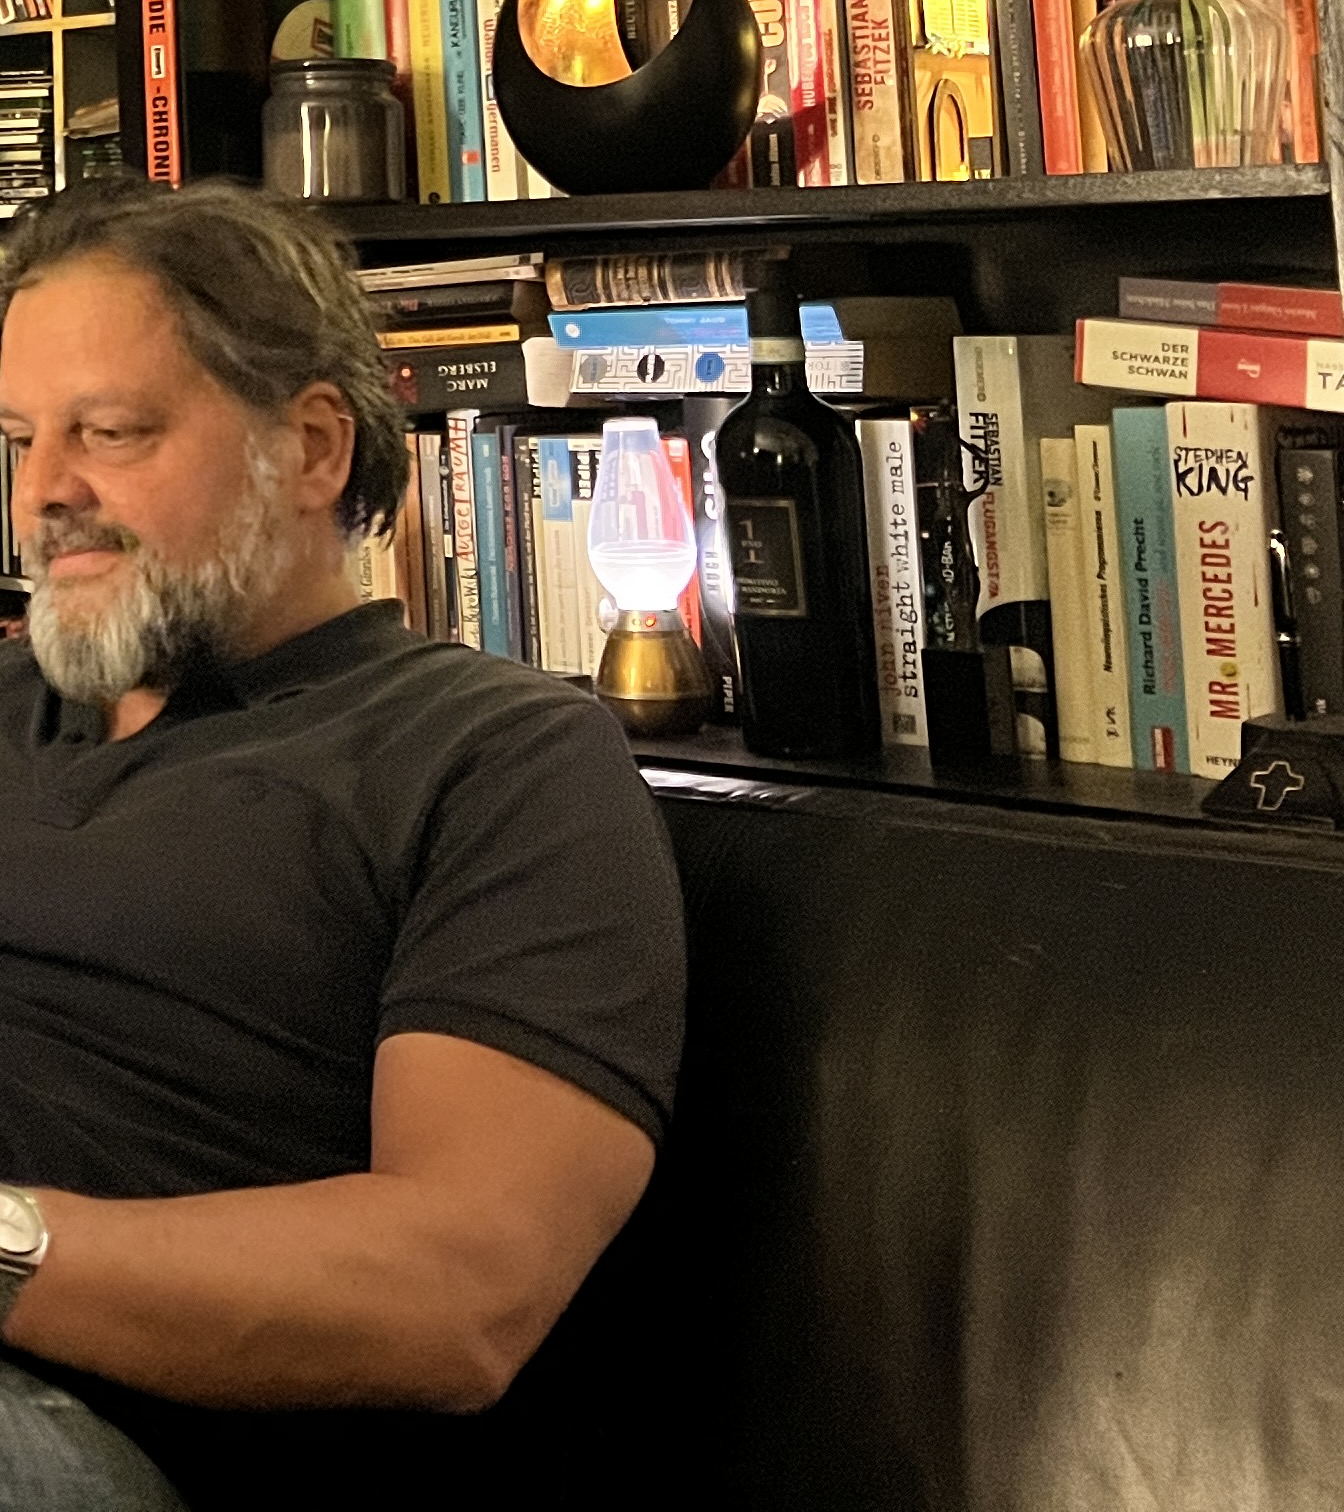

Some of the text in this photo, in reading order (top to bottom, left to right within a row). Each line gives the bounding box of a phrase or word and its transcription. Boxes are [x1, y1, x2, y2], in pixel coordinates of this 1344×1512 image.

[148, 0, 167, 34] DIE
[871, 15, 892, 87] FITZEK
[437, 360, 497, 377] ELSBERG
[1112, 351, 1189, 368] SCHWARZE
[1161, 342, 1190, 354] DER
[445, 377, 489, 392] MARC
[1128, 364, 1188, 380] SCHWAN
[968, 411, 988, 485] FITZEK
[986, 412, 1004, 488] SEBASTIAN
[1173, 445, 1249, 470] STEPHEN
[575, 451, 591, 499] PIPER
[1173, 457, 1255, 502] KING
[705, 550, 720, 593] HUGH
[885, 440, 919, 700] straight white male
[1132, 517, 1157, 696] Richard David Precht
[1198, 518, 1242, 721] MR MERCEDES
[875, 564, 902, 698] john niven
[722, 675, 735, 714] PIPER
[1205, 754, 1241, 768] HEYN
